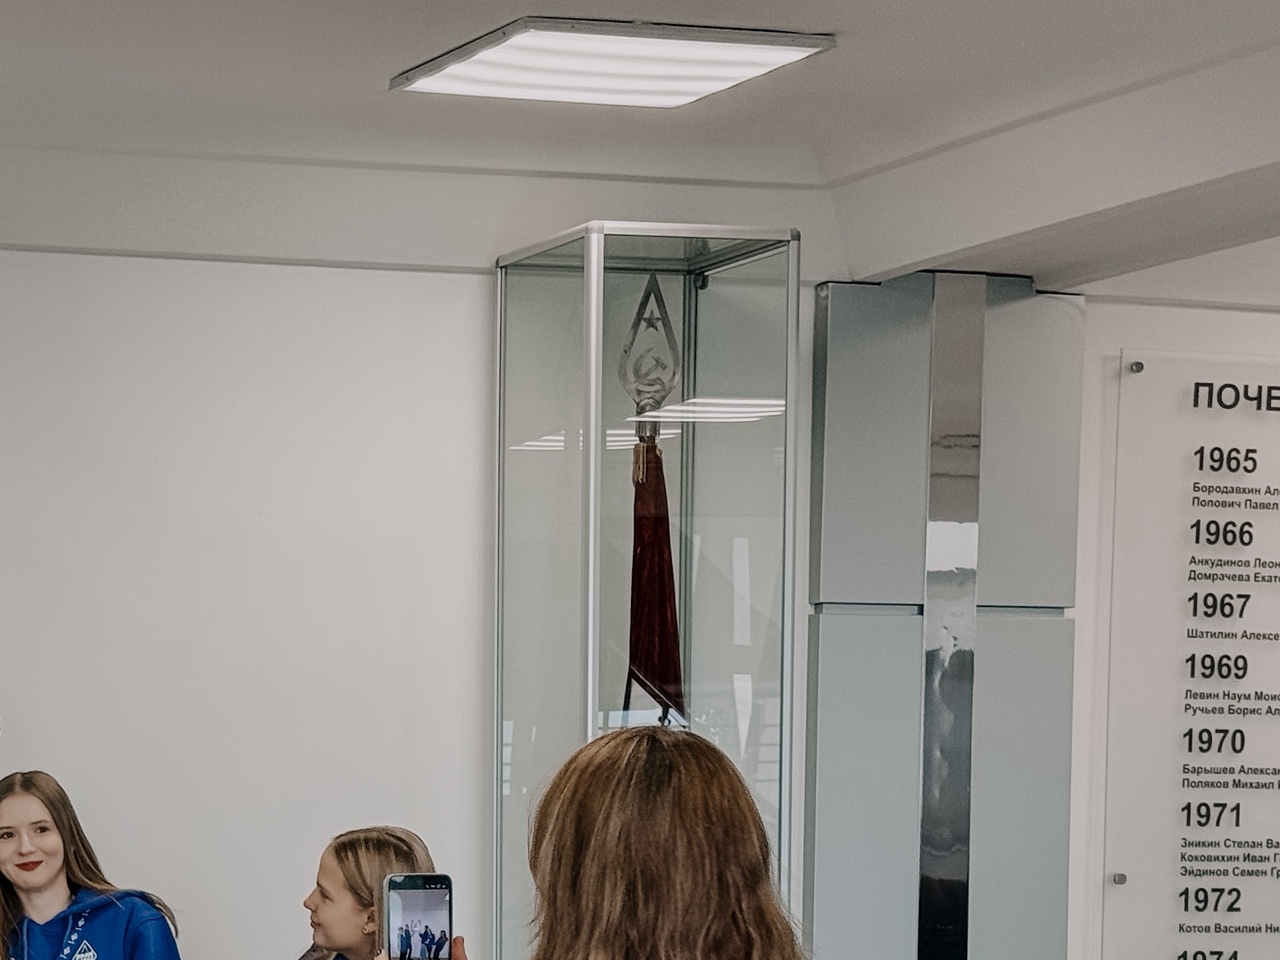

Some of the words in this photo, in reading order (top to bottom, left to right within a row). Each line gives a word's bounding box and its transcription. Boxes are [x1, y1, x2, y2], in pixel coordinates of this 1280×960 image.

[1193, 382, 1280, 411] ПОЧЕ
[1194, 446, 1257, 473] 1965
[1192, 482, 1261, 495] Бородавкин
[1264, 485, 1280, 496] Ал
[1192, 496, 1241, 508] Попович
[1244, 499, 1279, 510] Павел
[1190, 519, 1253, 546] 1966
[1189, 555, 1251, 569] Анкудинов
[1188, 570, 1250, 583] Домрачева
[1187, 592, 1251, 618] 1967
[1187, 628, 1238, 640] Шатилин
[1240, 630, 1280, 641] Алексе
[1185, 653, 1248, 680] 1969
[1184, 689, 1219, 700] Левин
[1222, 690, 1251, 703] Наум
[1184, 703, 1224, 716] Ручьев
[1228, 704, 1262, 717] Борис
[1183, 728, 1246, 754] 1970
[1182, 764, 1235, 776] Барышев
[1182, 778, 1229, 789] Поляков
[1232, 779, 1274, 790] Михаил
[1181, 802, 1241, 827] 1971
[1180, 837, 1220, 848] Зникин
[1224, 838, 1263, 849] Степан
[1180, 852, 1240, 863] Коковихин
[1243, 852, 1270, 863] Иван
[1180, 866, 1229, 878] Эйдинов
[1232, 866, 1267, 877] Семен
[1179, 887, 1241, 912] 1972
[1178, 923, 1211, 933] Котов
[1214, 922, 1262, 933] Василий
